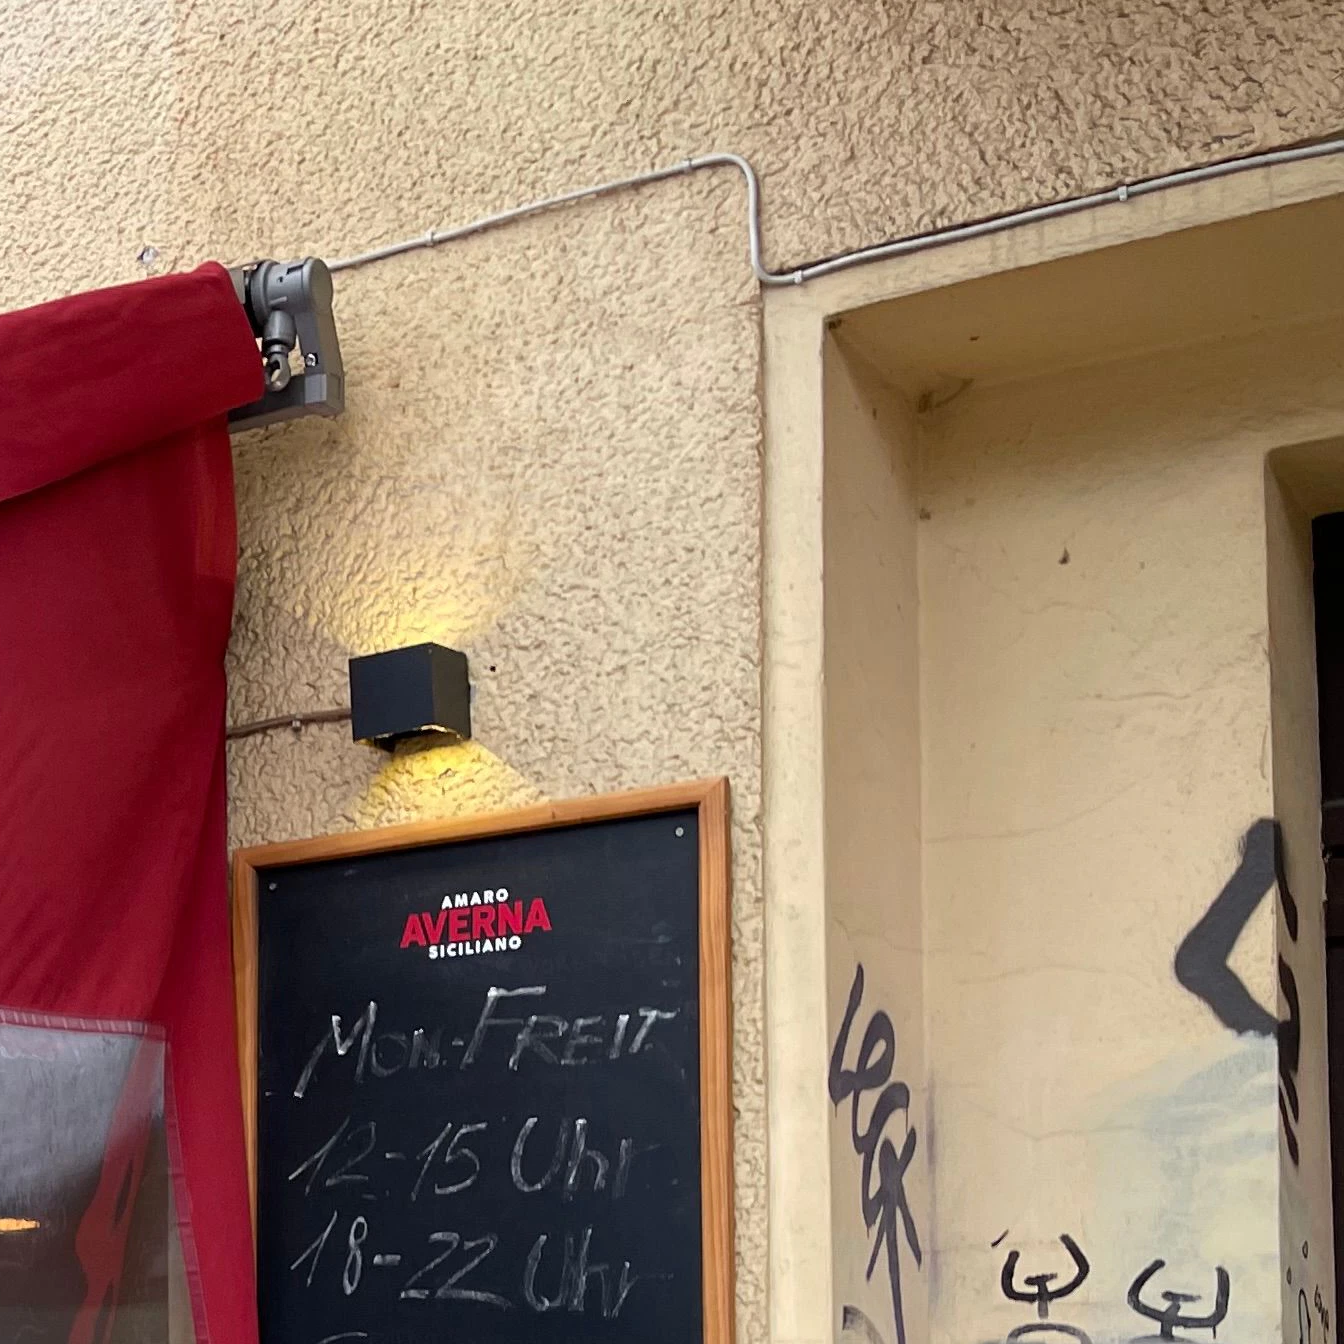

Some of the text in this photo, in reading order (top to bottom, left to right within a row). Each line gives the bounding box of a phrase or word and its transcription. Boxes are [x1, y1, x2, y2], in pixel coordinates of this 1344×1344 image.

[399, 897, 553, 949] AVERNA
[441, 888, 510, 910] AMARO
[427, 935, 523, 960] SICILIANO
[510, 1115, 657, 1202] Uhr
[289, 1210, 670, 1319] 18-22 Uhr
